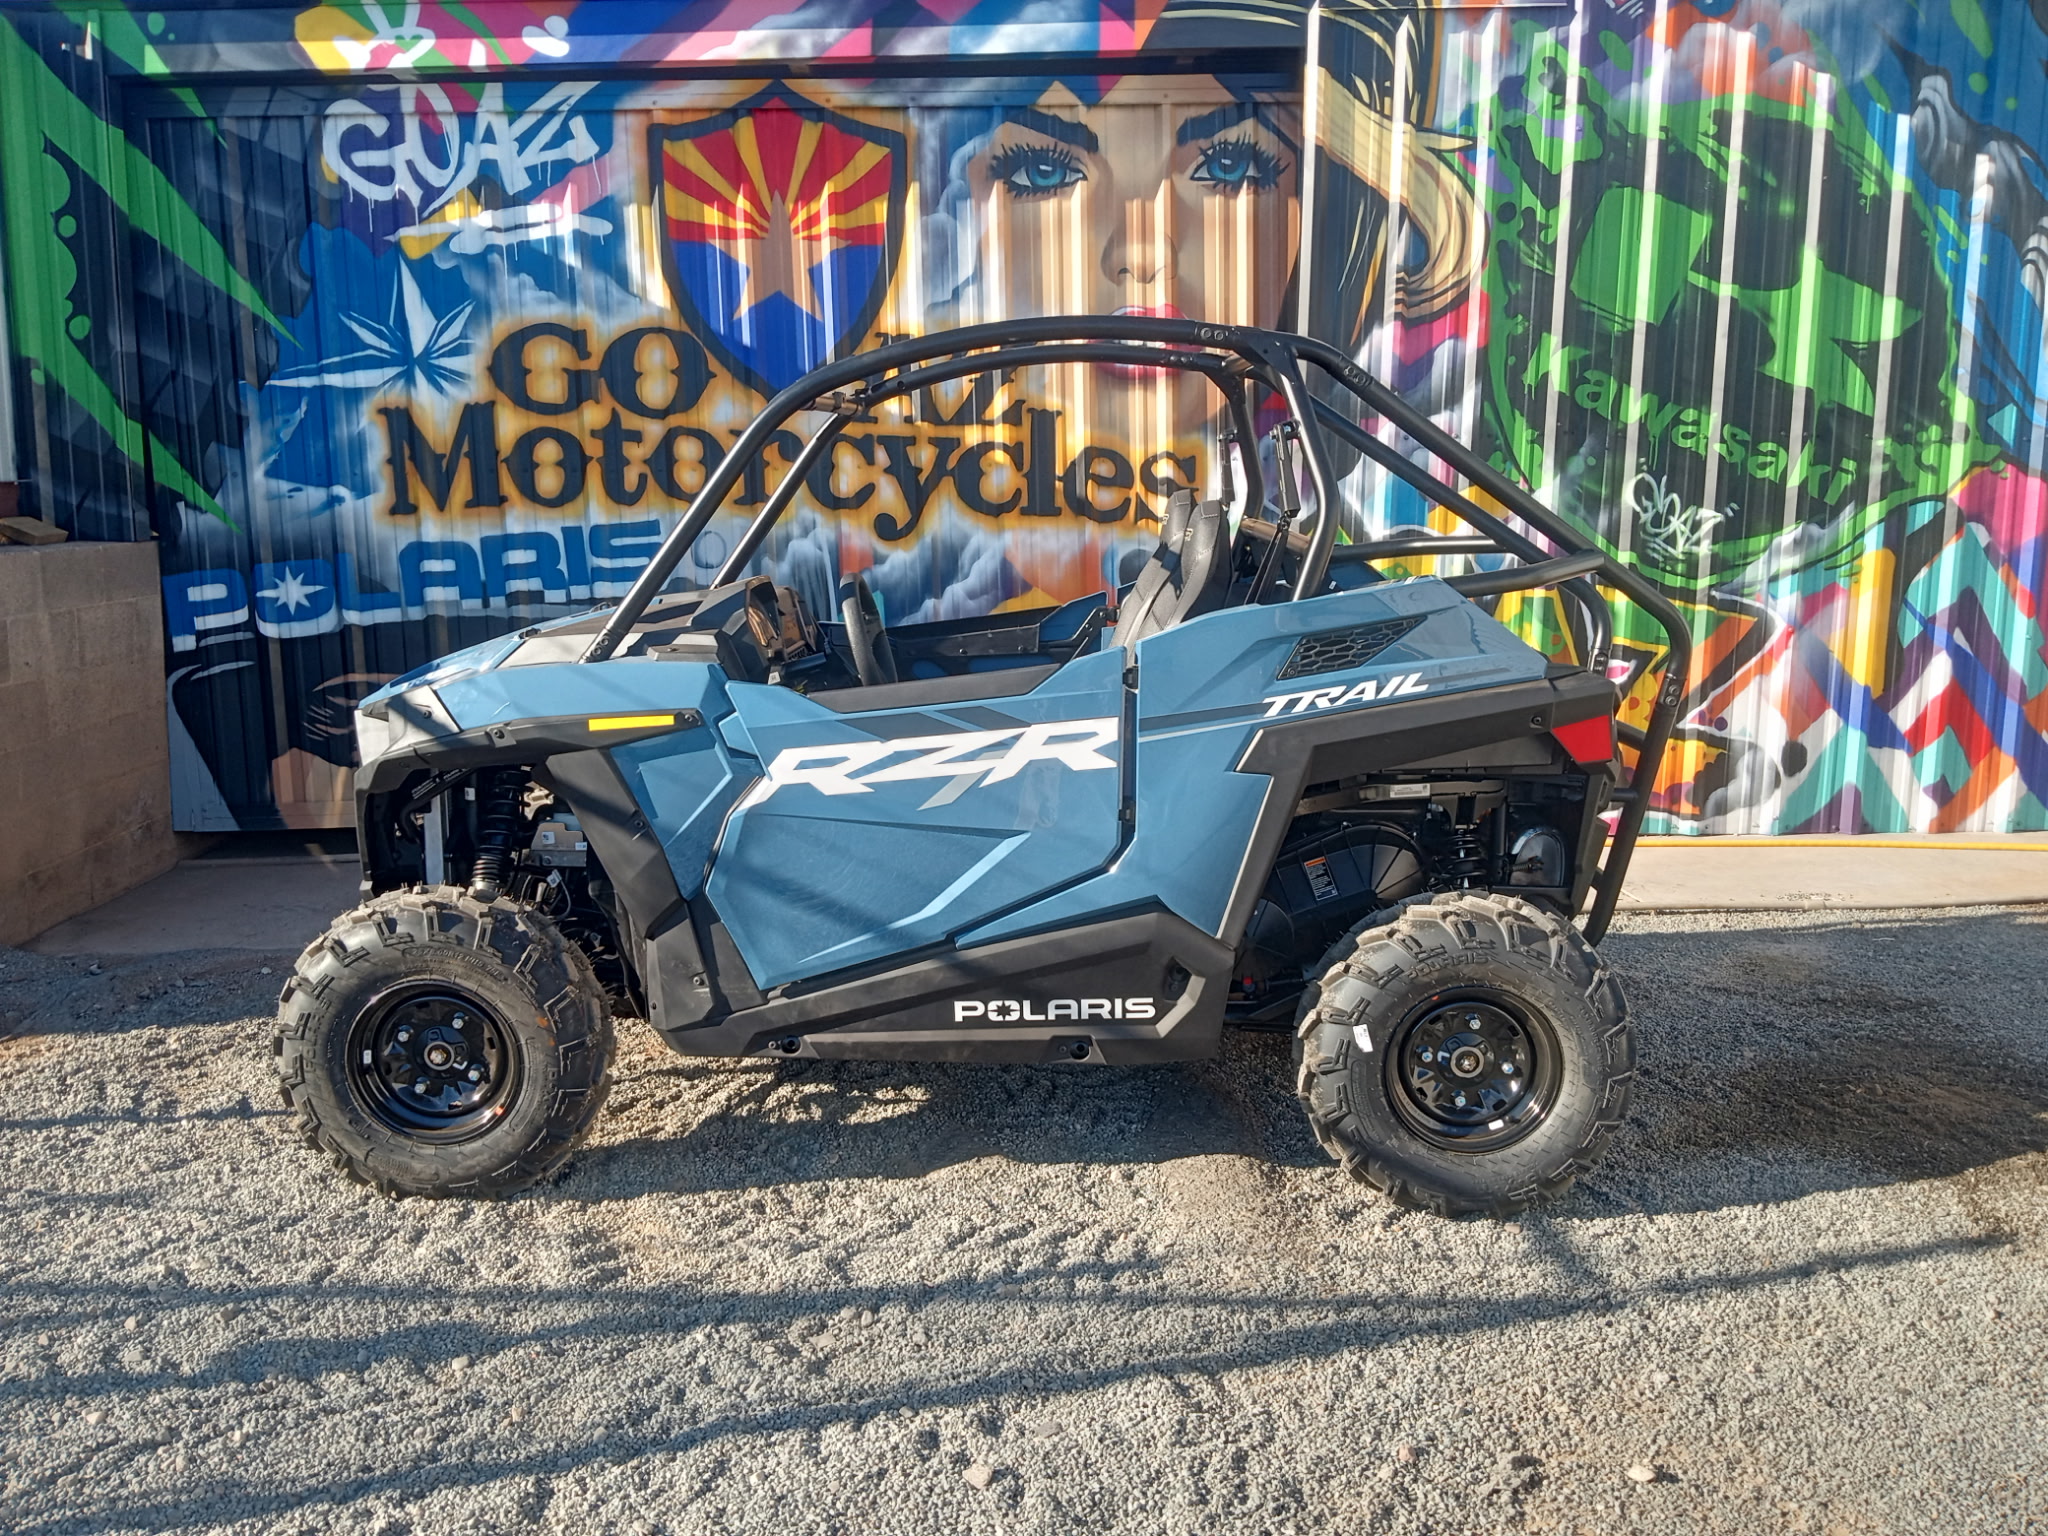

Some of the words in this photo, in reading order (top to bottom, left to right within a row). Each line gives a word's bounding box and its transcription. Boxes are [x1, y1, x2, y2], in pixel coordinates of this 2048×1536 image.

[487, 323, 717, 419] GO
[377, 400, 1199, 541] Motorcycles
[162, 519, 662, 652] POLARIS
[1262, 672, 1429, 718] TRAIL
[757, 716, 1119, 803] RZR
[954, 997, 1156, 1022] POLARIS
